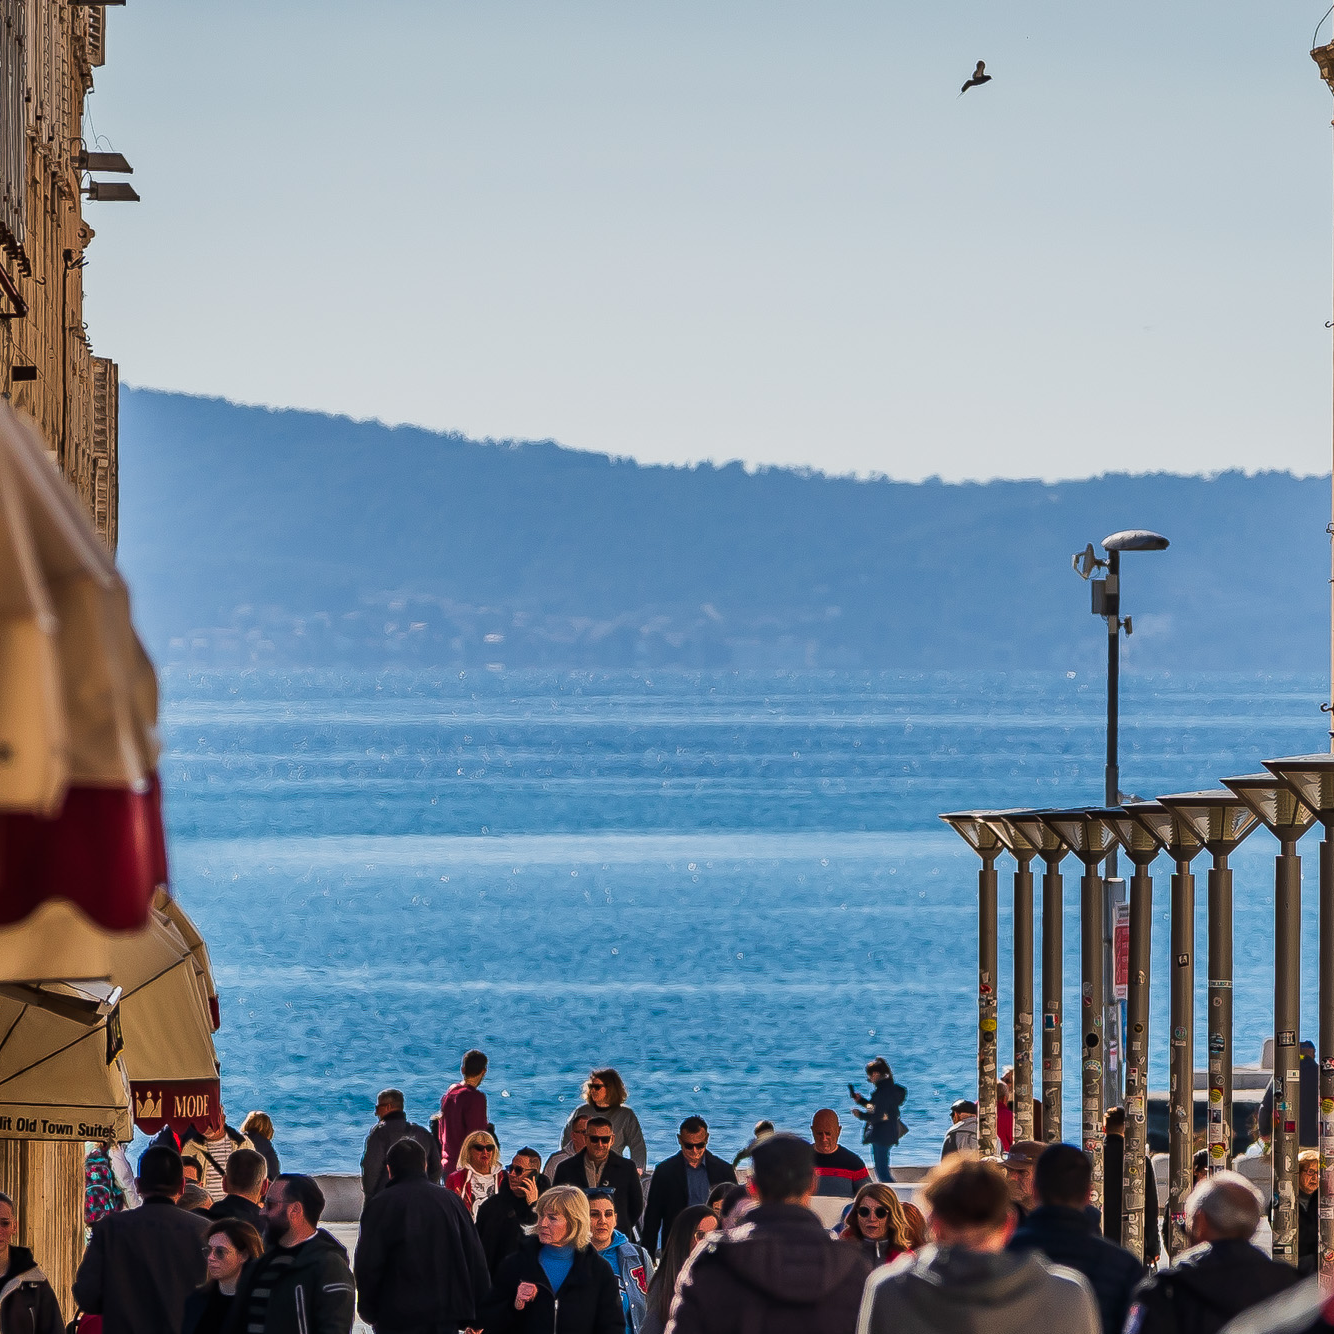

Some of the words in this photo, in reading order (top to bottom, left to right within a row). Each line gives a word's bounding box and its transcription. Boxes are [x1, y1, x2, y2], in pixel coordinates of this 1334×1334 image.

[173, 1094, 210, 1118] MODE
[16, 1117, 37, 1133] Old
[41, 1119, 74, 1136] Town
[77, 1122, 117, 1139] Suites
